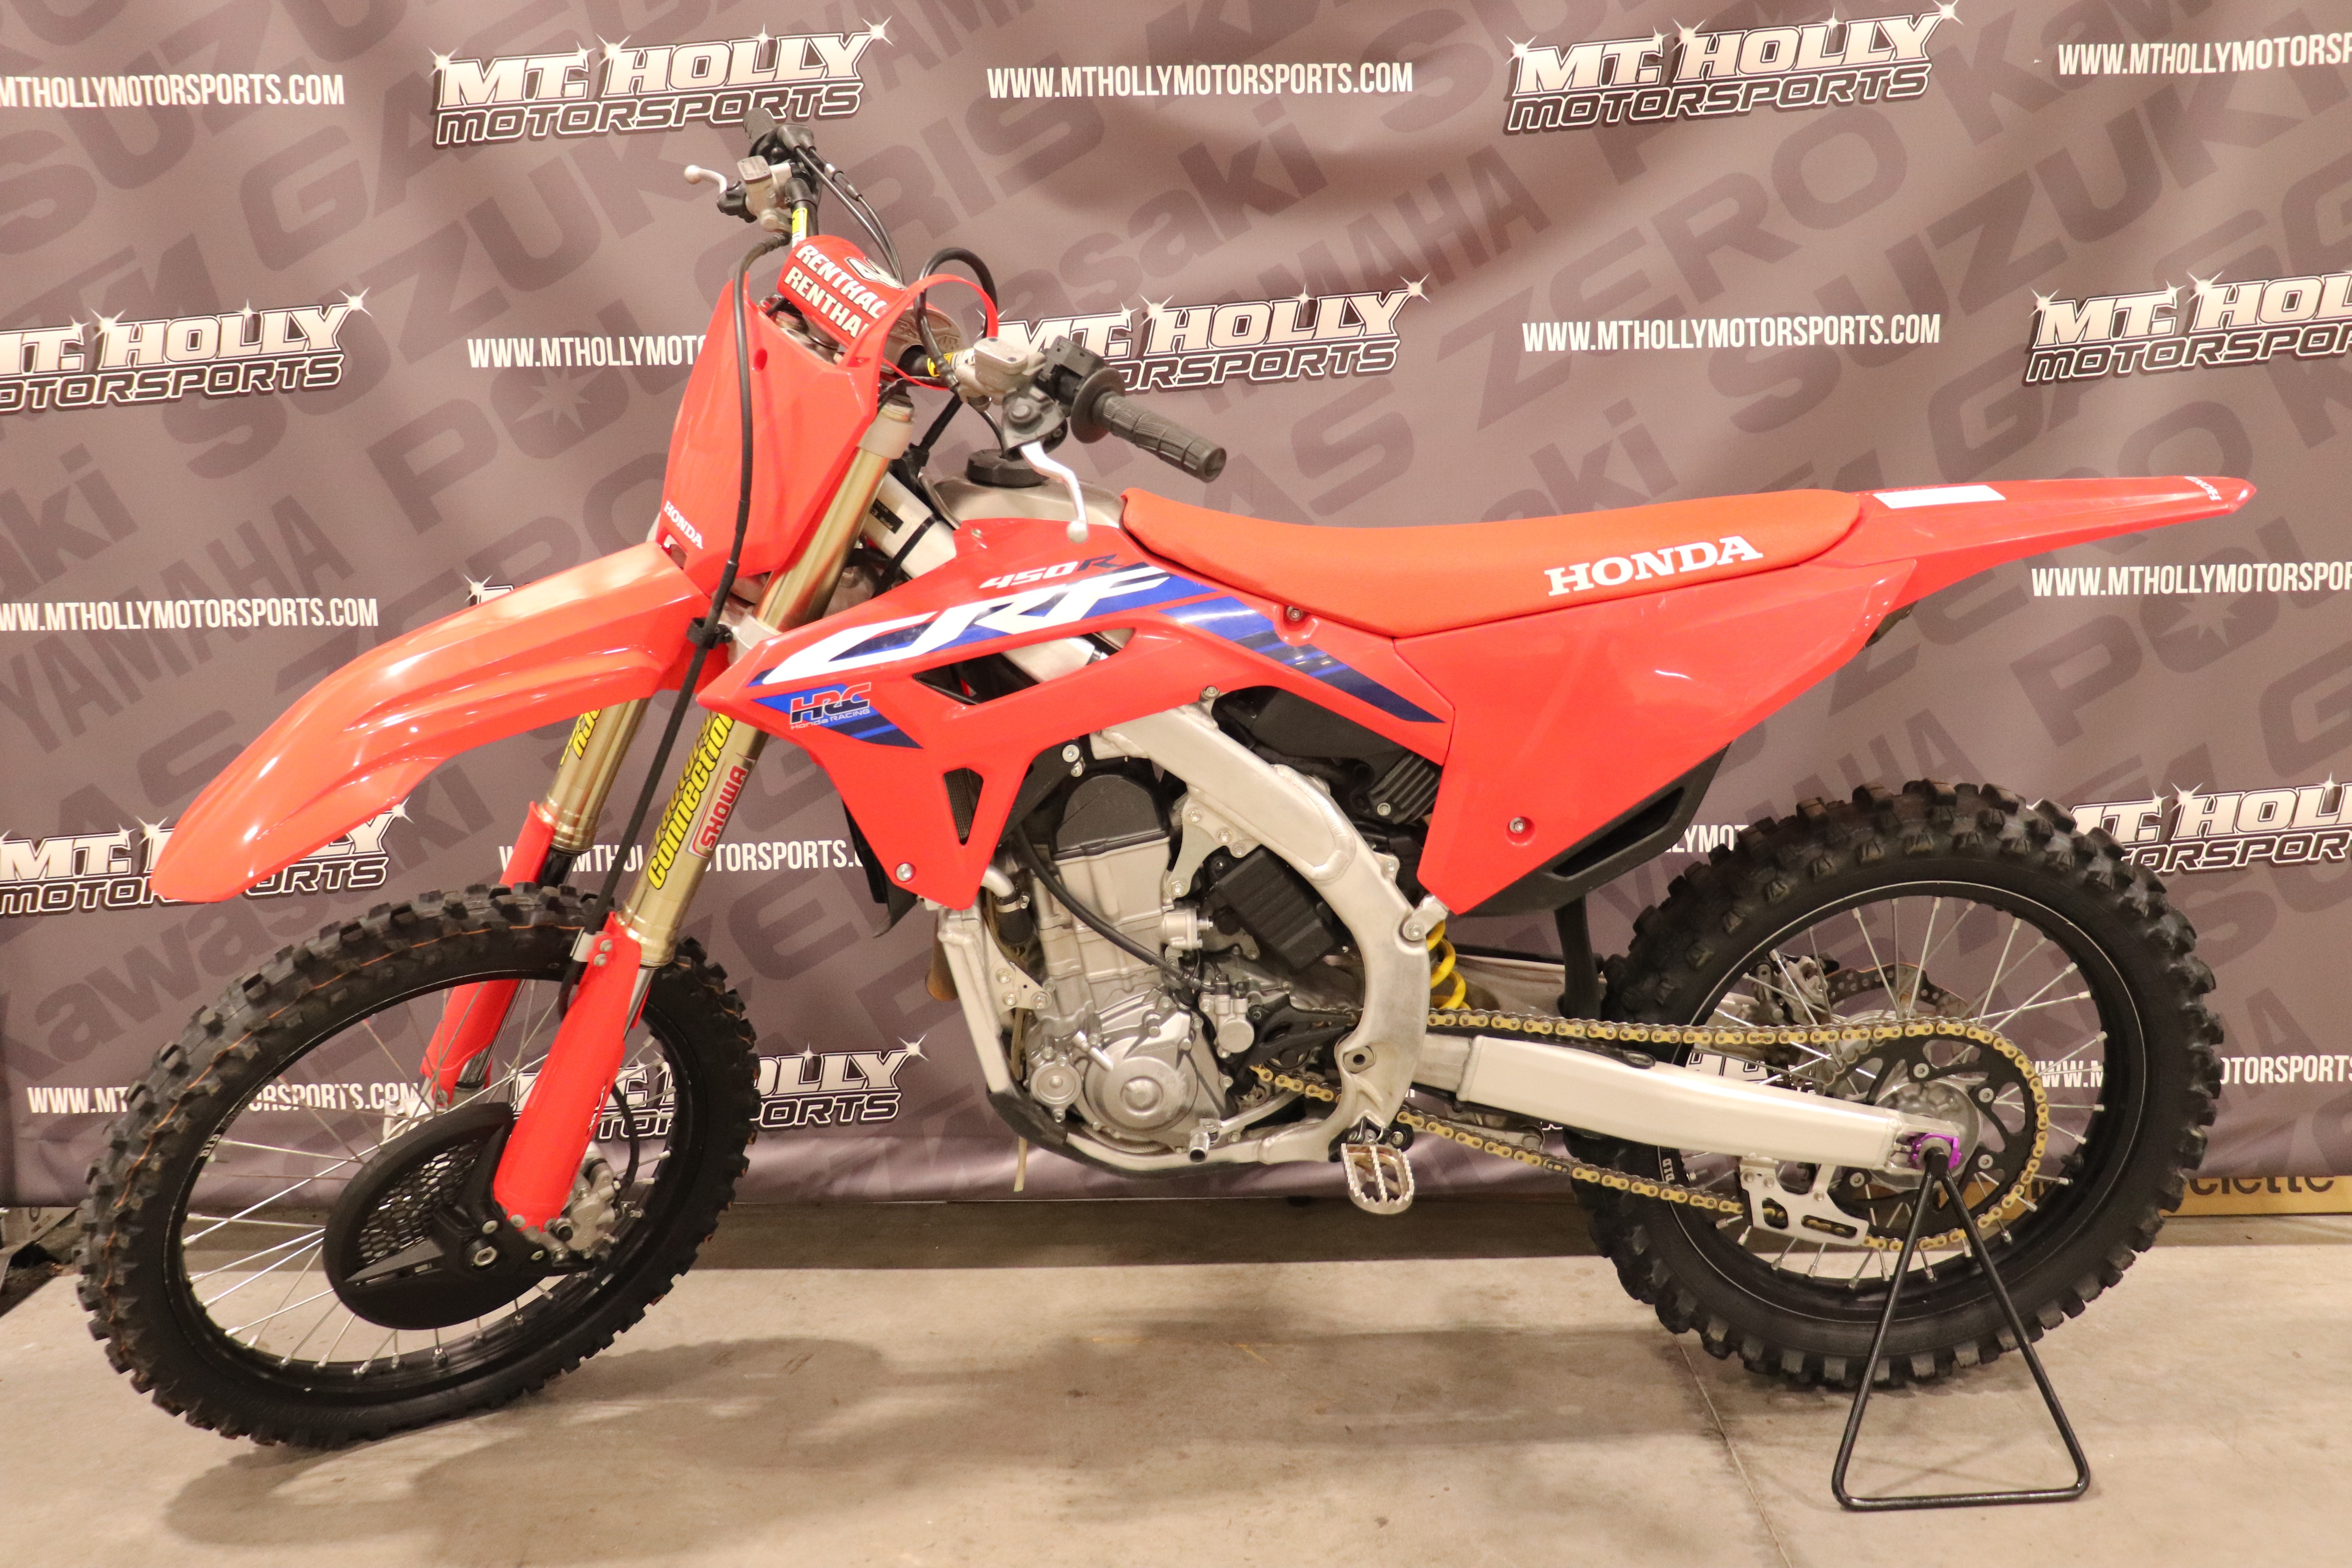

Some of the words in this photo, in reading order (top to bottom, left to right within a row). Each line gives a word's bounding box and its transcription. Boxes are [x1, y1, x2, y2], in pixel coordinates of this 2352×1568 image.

[436, 52, 588, 109] MT.
[597, 31, 873, 99] HOLLY
[987, 63, 1413, 98] WWW.MTHOLLYMOTORSPORTS.COM
[1512, 38, 1664, 97] MT.
[1673, 13, 1942, 86] HOLLY
[0, 73, 345, 108] MTHOLLYMOTORSPORTS.COM
[435, 82, 864, 145] MOTORSPORTS
[1508, 64, 1931, 131] MOTORSPORTS
[795, 245, 889, 319] RENTHAL
[97, 304, 351, 371] HOLLY
[1145, 289, 1413, 357] HOLLY
[1522, 319, 1940, 352] WWW.MTHOLLYMOTORSPORTS.COM
[2034, 289, 2180, 348] MT.
[467, 335, 707, 368] WWW.MTHOLLYMOT
[1111, 338, 1401, 392] ORSPORTS
[663, 500, 704, 550] HONDA
[978, 554, 1124, 589] 450R
[1544, 535, 1764, 596] HONDA
[761, 564, 1172, 685] CRF
[789, 682, 871, 725] HRC
[791, 718, 829, 730] Honda
[830, 708, 871, 722] RACING
[700, 765, 748, 851] SHOWA
[1662, 1158, 1675, 1182] DID
